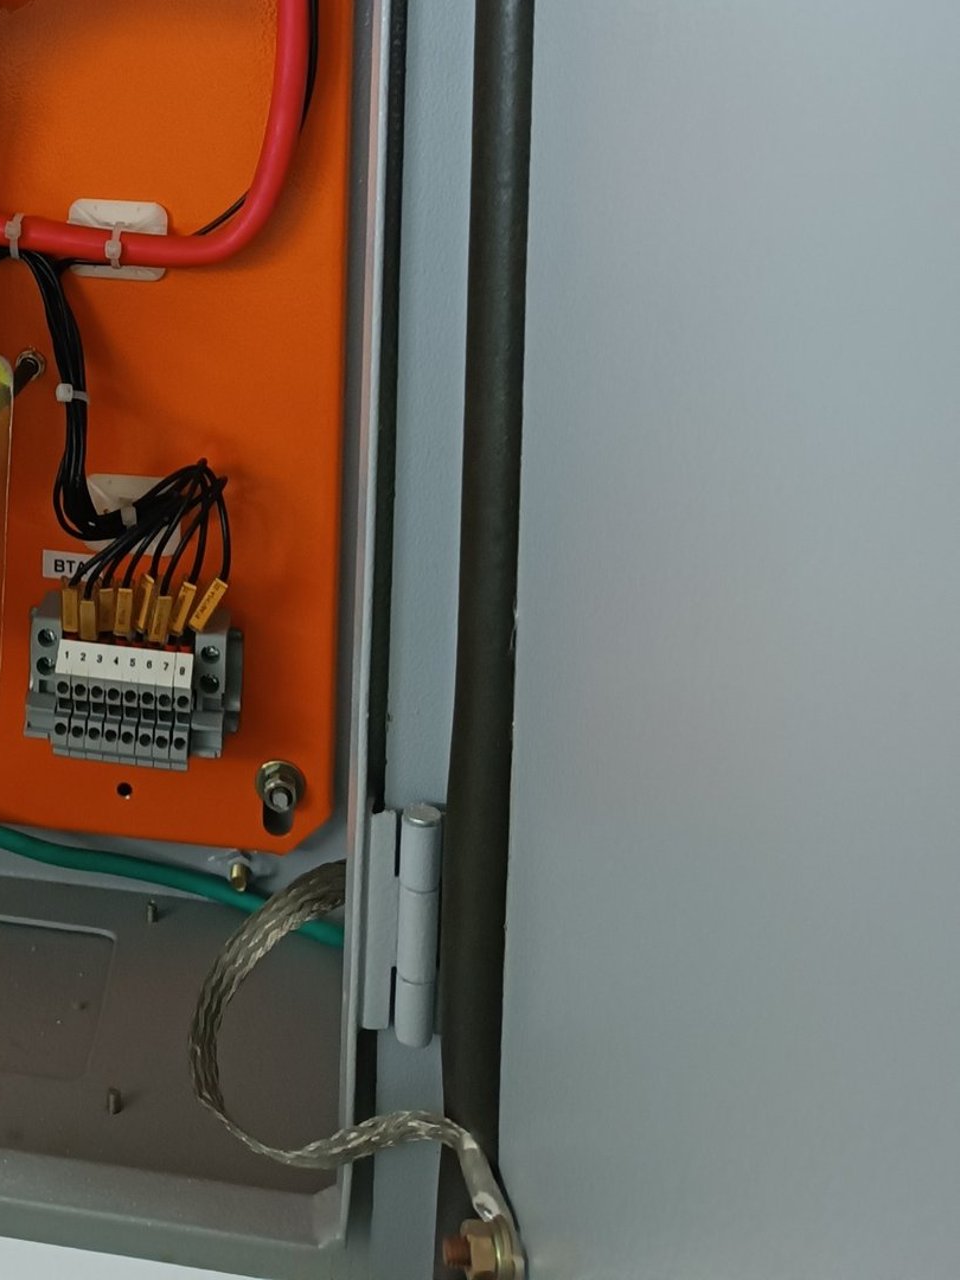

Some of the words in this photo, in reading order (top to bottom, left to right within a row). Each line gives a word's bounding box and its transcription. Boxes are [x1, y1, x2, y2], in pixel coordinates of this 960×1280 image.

[64, 651, 70, 659] 1
[80, 652, 86, 662] 2
[96, 654, 103, 663] 3
[114, 656, 120, 665] 4
[130, 658, 136, 667] 5
[146, 659, 152, 669] 6
[163, 662, 169, 671] 7
